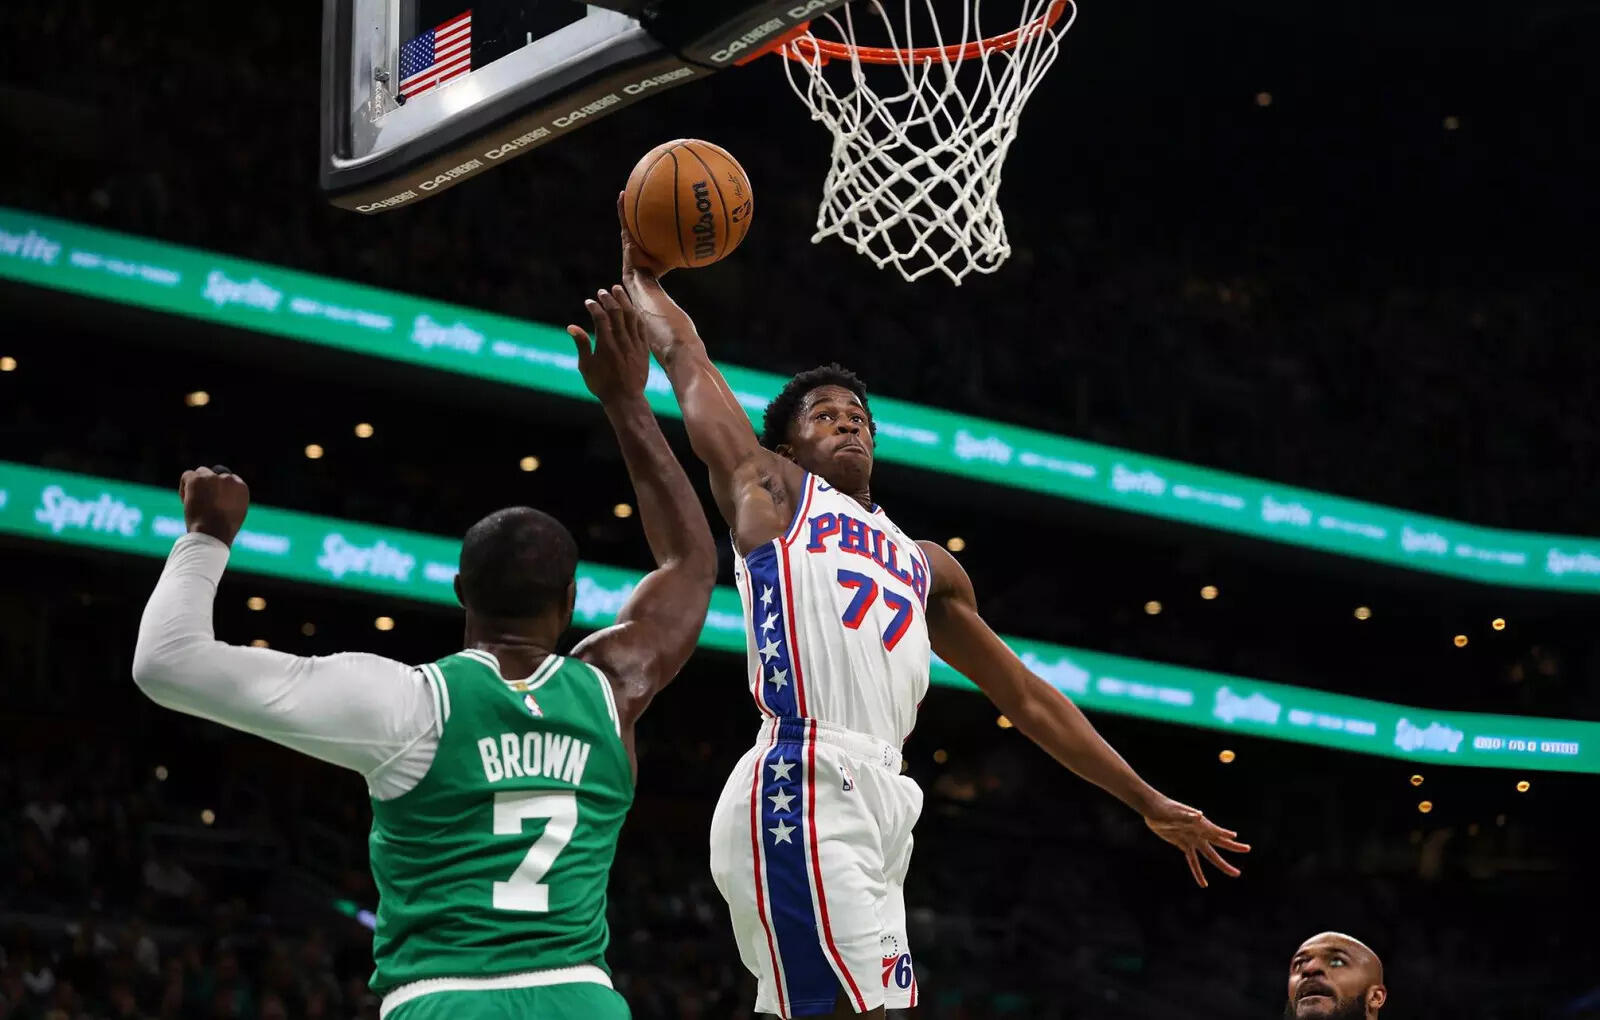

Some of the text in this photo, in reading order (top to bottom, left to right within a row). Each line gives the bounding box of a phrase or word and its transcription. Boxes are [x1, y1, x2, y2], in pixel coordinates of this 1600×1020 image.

[710, 40, 748, 62] C4
[623, 79, 659, 95] C4
[552, 110, 587, 128] C4
[484, 143, 518, 160] C4
[418, 174, 452, 191] C4
[35, 485, 142, 537] Sprite
[837, 568, 913, 653] 77
[477, 731, 591, 787] BROWN
[492, 789, 578, 913] 7
[881, 952, 912, 990] 76
